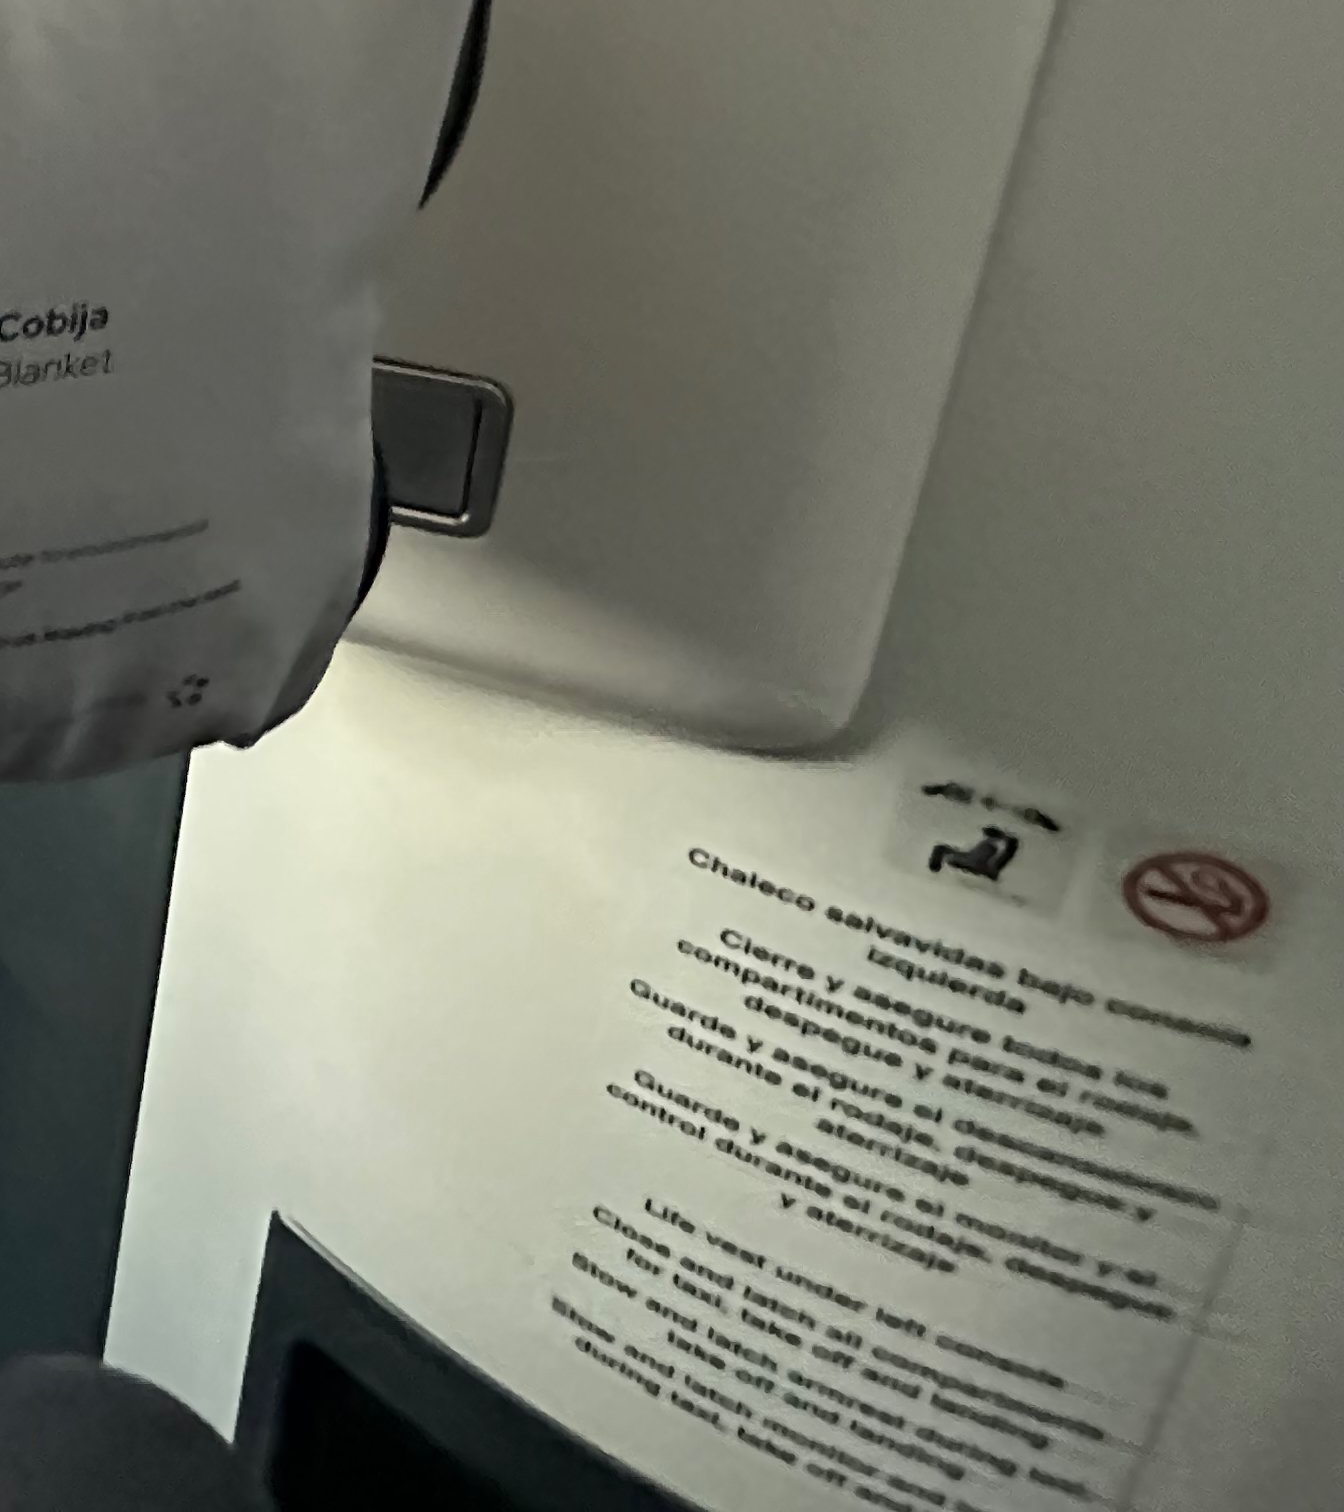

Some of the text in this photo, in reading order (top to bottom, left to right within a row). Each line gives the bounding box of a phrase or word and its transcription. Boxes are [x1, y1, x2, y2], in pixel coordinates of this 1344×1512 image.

[688, 847, 816, 912] Chaleco
[826, 904, 1005, 979] salvavidas
[677, 938, 938, 1055] compartimentos
[948, 1047, 1026, 1084] para
[719, 927, 816, 981] Cierre
[825, 973, 845, 994] y
[853, 984, 992, 1045] asegure
[630, 978, 943, 1124] Guarde y asegure el
[667, 1025, 783, 1086] durante
[792, 1081, 822, 1103] el
[744, 994, 904, 1068] despegue
[914, 1061, 934, 1082] y
[606, 1084, 706, 1140] control
[714, 1137, 832, 1199] durante
[842, 1194, 871, 1215] el
[634, 1069, 740, 1133] Guarde
[750, 1125, 767, 1145] y
[775, 1141, 906, 1203] asegure
[915, 1197, 945, 1218] el
[645, 1198, 696, 1234] Life
[705, 1231, 767, 1270] vest
[780, 1191, 797, 1210] y
[593, 1206, 671, 1259] Close
[679, 1256, 734, 1290] and
[626, 1247, 662, 1276] for
[572, 1251, 637, 1299] Stow
[645, 1297, 698, 1333] and
[624, 1345, 675, 1379] and
[667, 1329, 726, 1370] take
